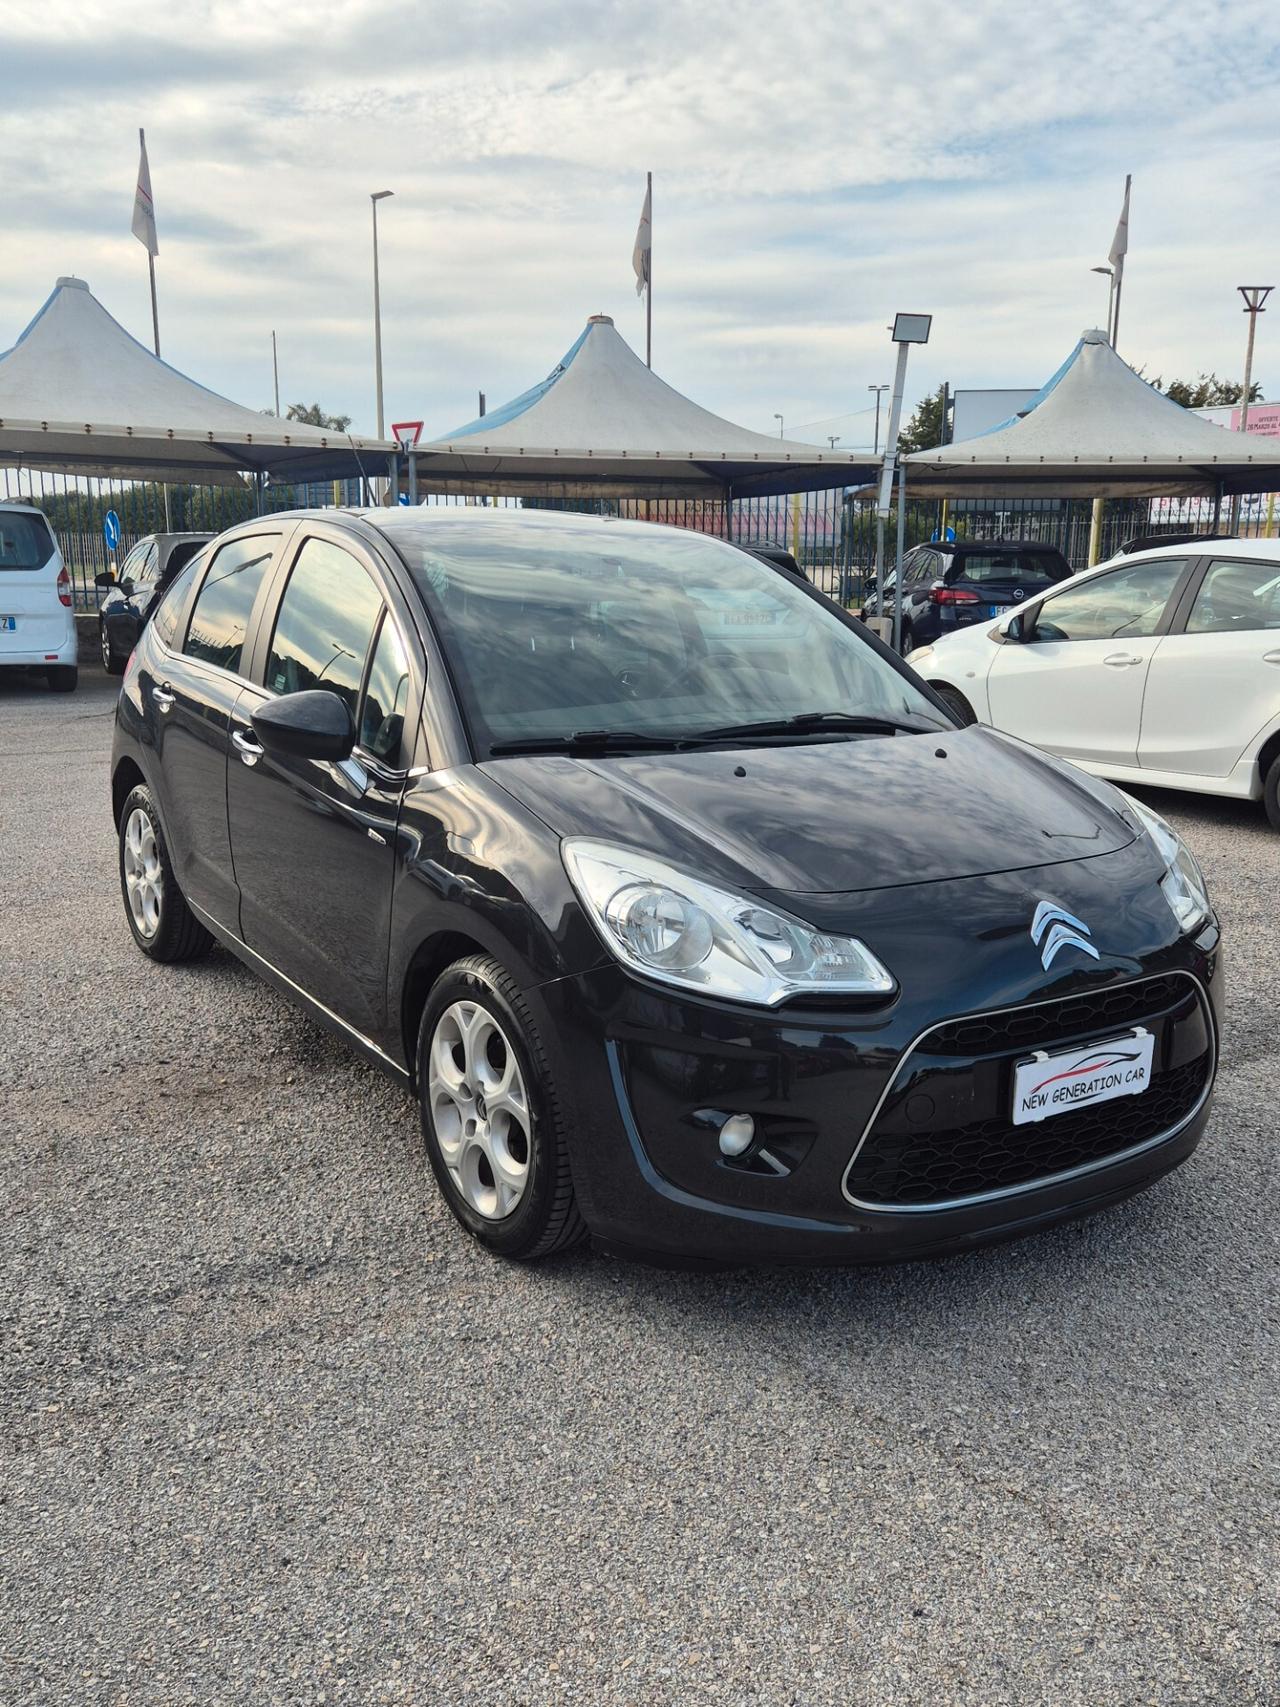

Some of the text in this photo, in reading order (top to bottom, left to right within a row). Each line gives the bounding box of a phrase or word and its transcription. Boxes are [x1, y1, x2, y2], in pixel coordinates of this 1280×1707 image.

[1021, 1067, 1145, 1112] NEW GENERATION CAR
